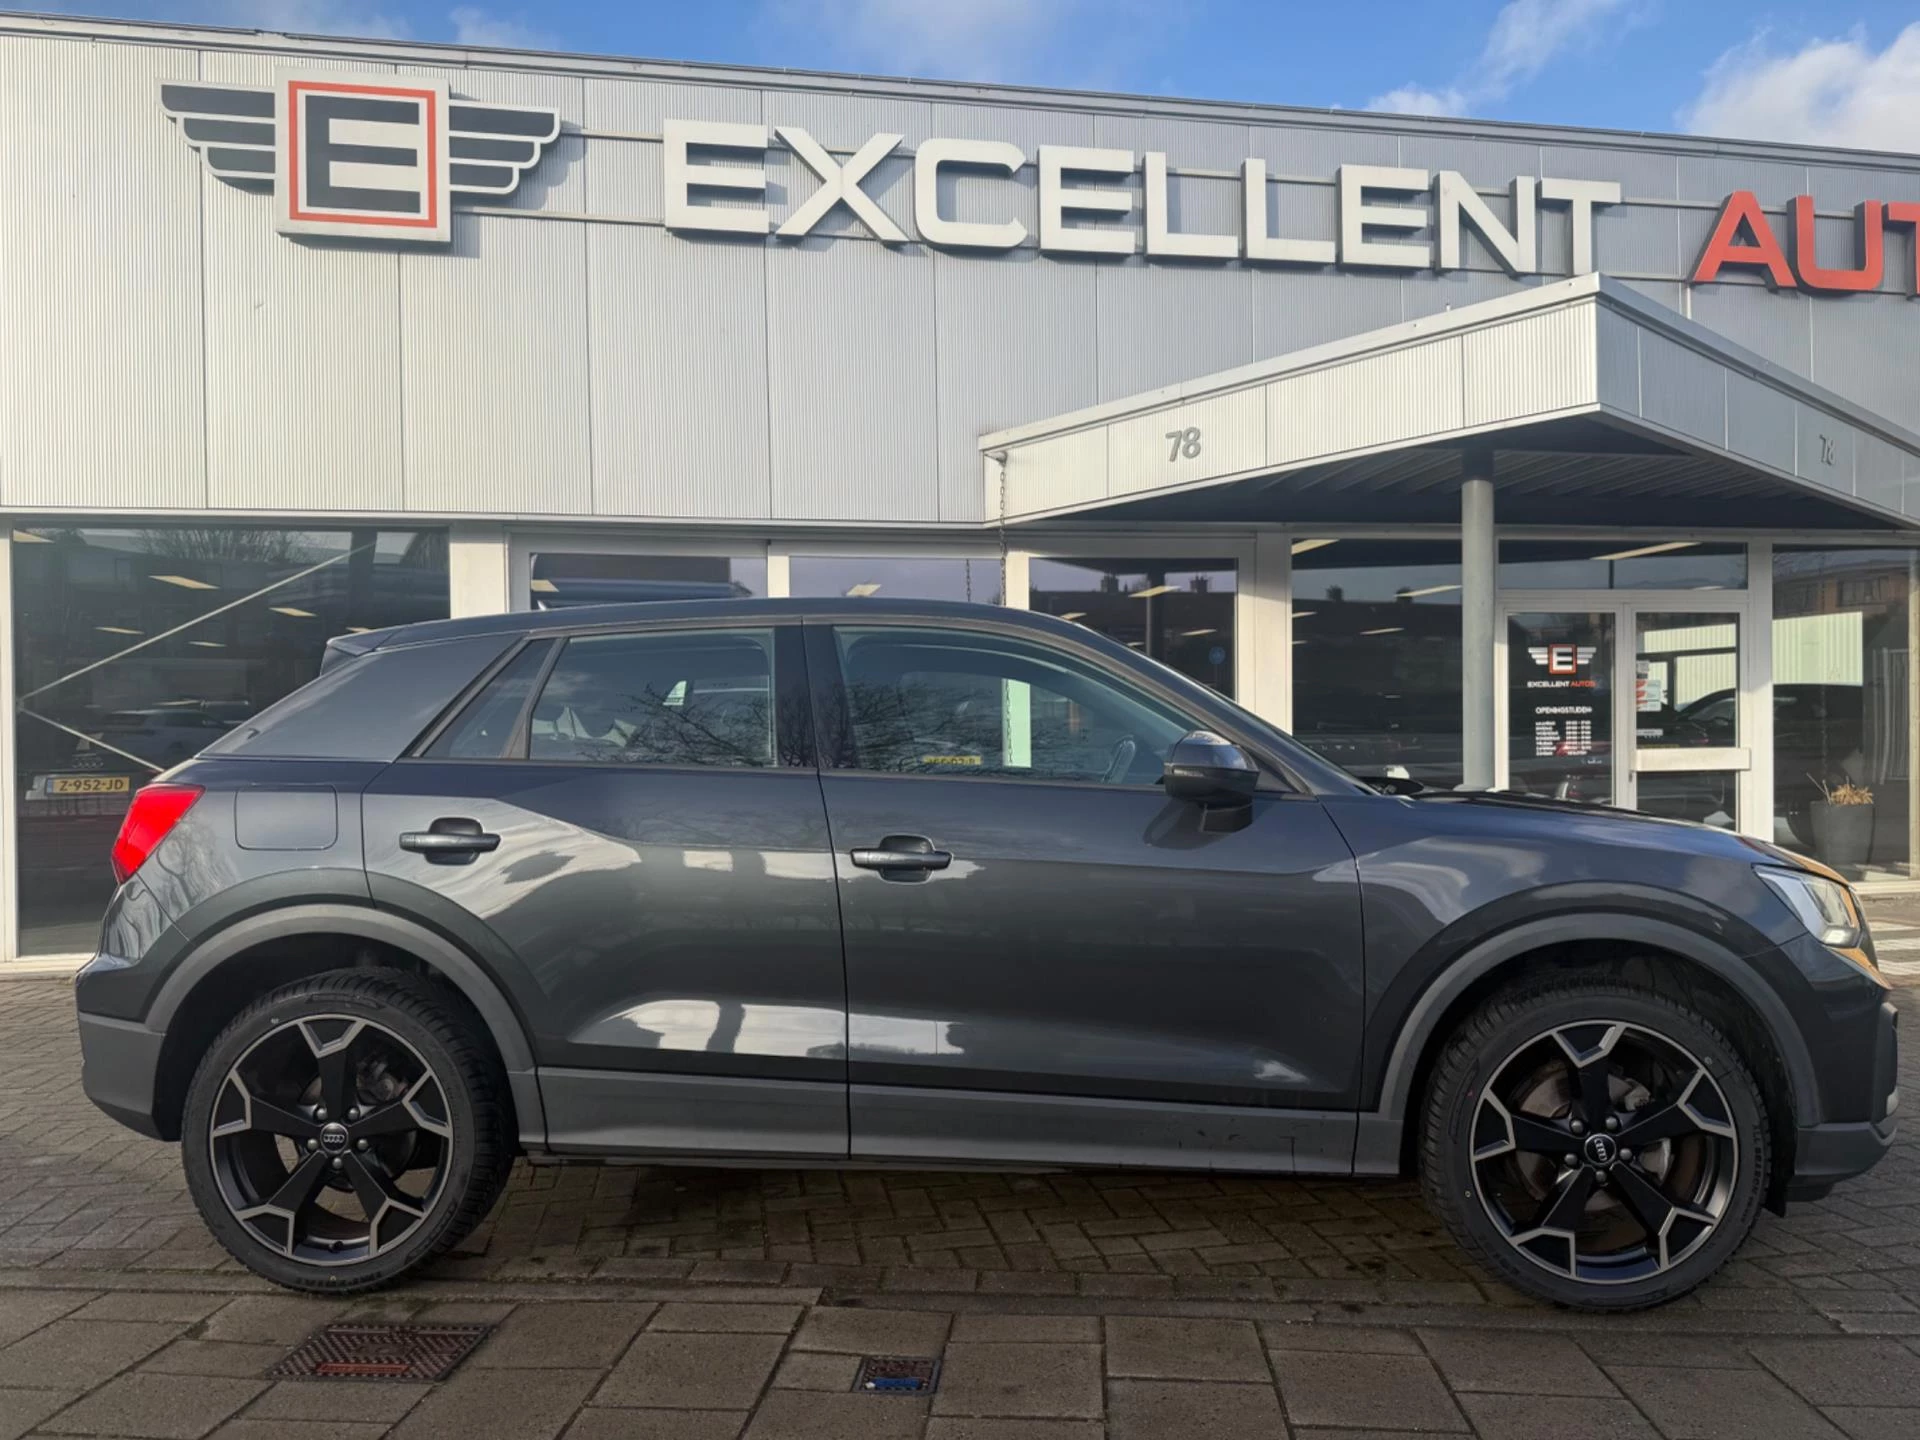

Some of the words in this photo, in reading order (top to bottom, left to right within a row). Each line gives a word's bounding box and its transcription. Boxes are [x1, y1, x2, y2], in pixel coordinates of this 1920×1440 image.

[662, 118, 1622, 276] EXCELLENT
[1165, 427, 1201, 462] 78
[1819, 434, 1836, 466] 78
[1552, 647, 1573, 670] E
[59, 779, 124, 792] Z-952-JD
